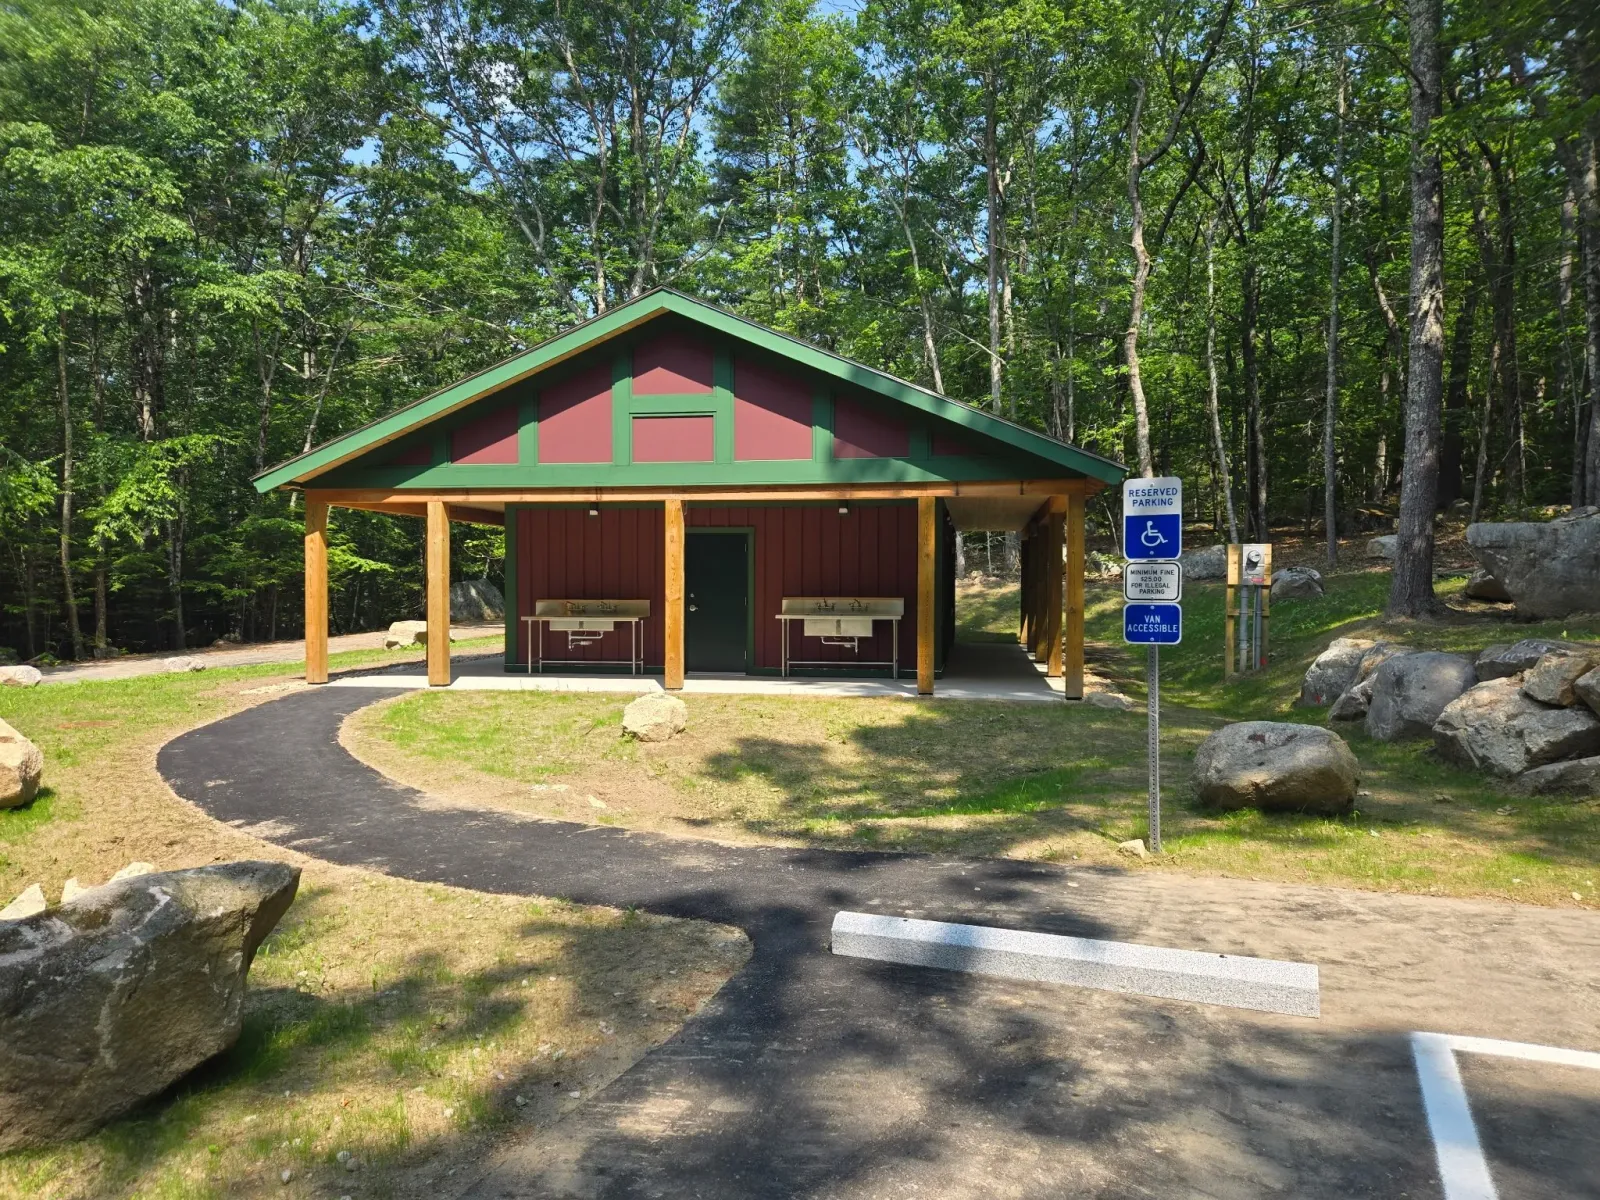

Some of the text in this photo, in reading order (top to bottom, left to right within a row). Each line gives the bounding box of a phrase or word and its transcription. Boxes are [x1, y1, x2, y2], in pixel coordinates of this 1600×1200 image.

[1128, 487, 1178, 497] RESERVED
[1132, 498, 1173, 507] PARKING
[1144, 615, 1161, 623] VAN
[1127, 624, 1179, 632] ACCESSIBLE
